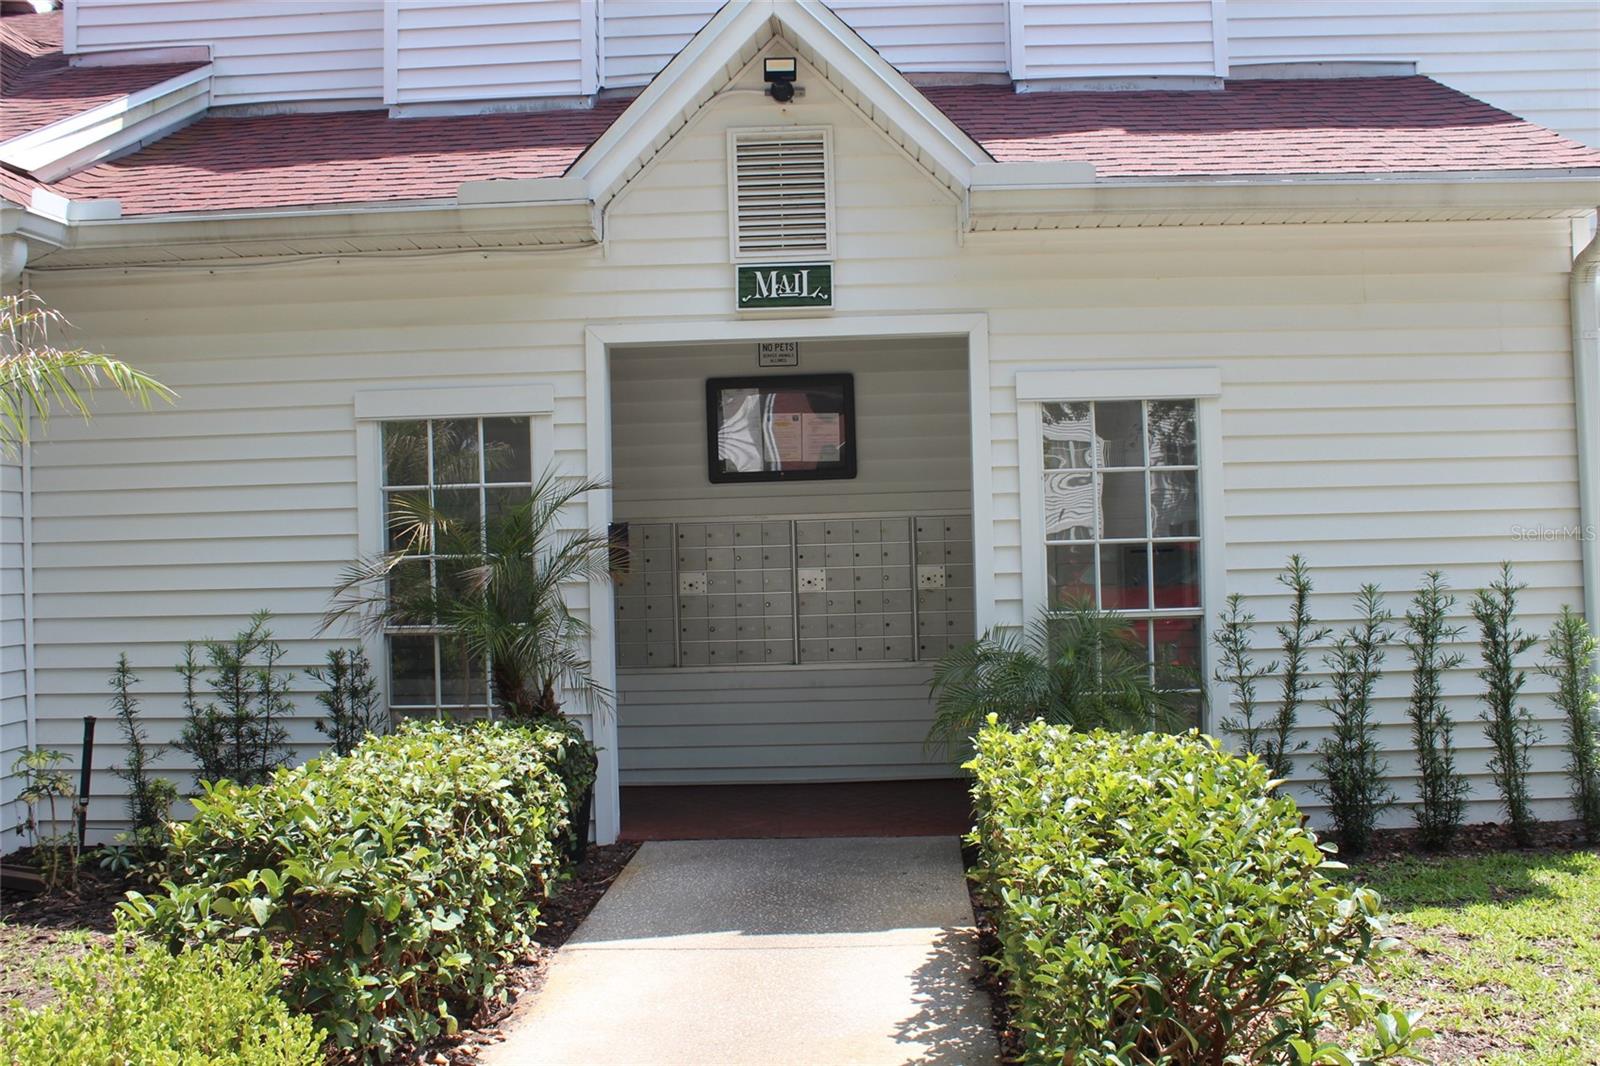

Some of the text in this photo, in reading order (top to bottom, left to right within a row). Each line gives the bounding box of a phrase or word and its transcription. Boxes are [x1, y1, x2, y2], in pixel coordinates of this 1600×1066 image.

[753, 269, 821, 299] MAIL
[762, 342, 794, 352] NO PETS
